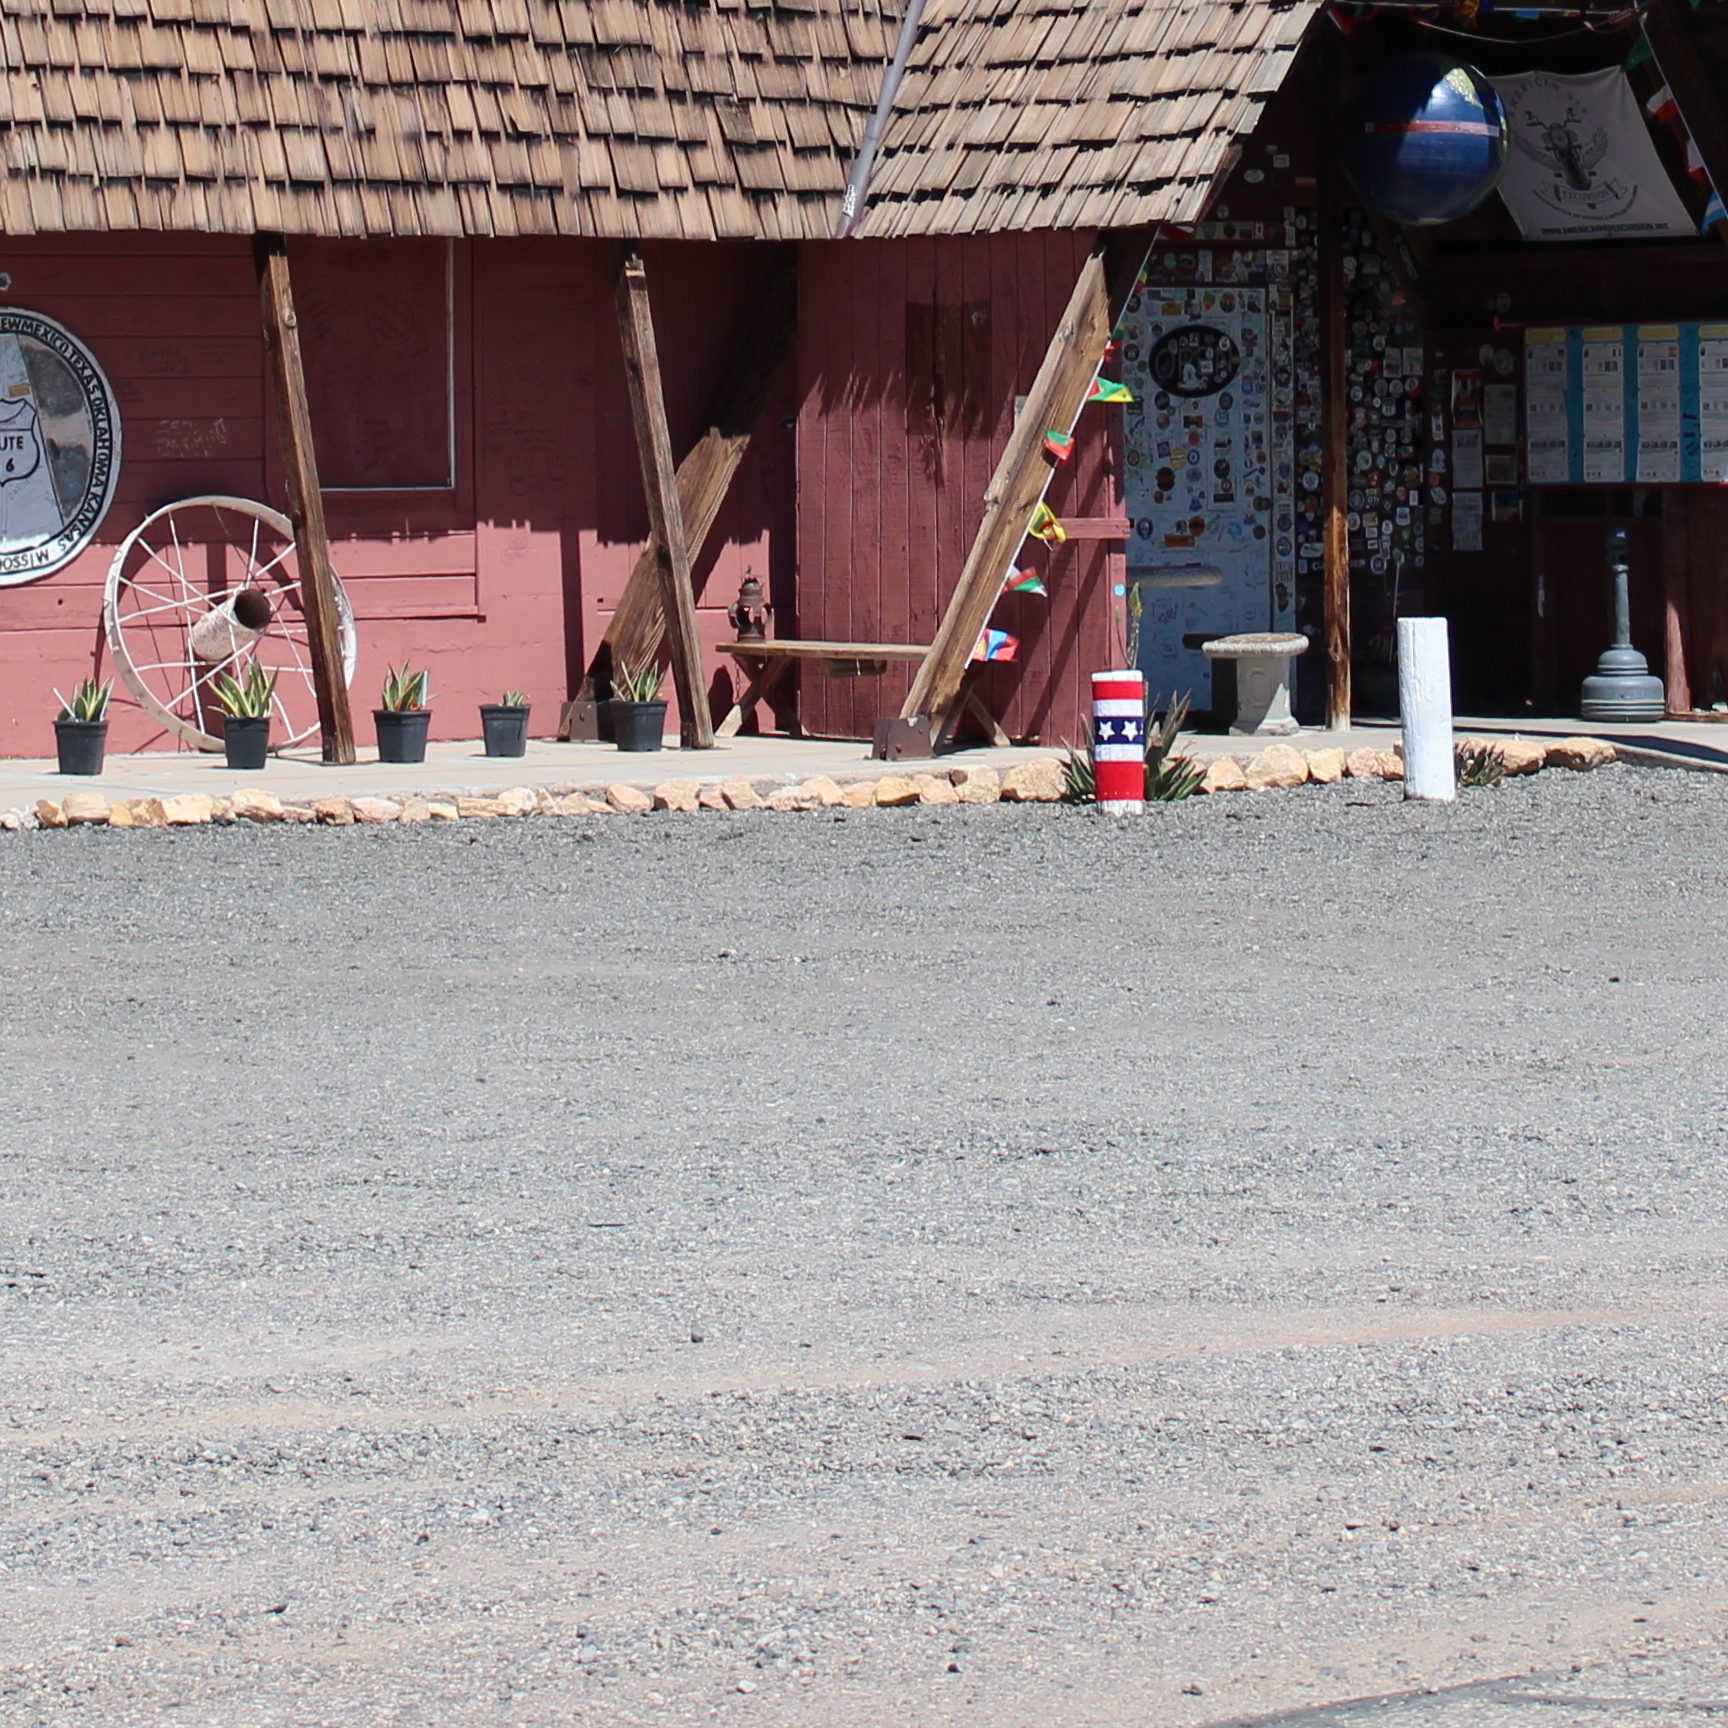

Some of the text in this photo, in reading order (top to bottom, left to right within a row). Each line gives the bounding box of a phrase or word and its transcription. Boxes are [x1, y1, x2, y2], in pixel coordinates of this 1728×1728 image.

[1508, 75, 1560, 119] AMERICAN
[68, 348, 100, 400] TEXAS
[91, 395, 111, 488] OKLAHOMA
[59, 490, 101, 552] KANSAS
